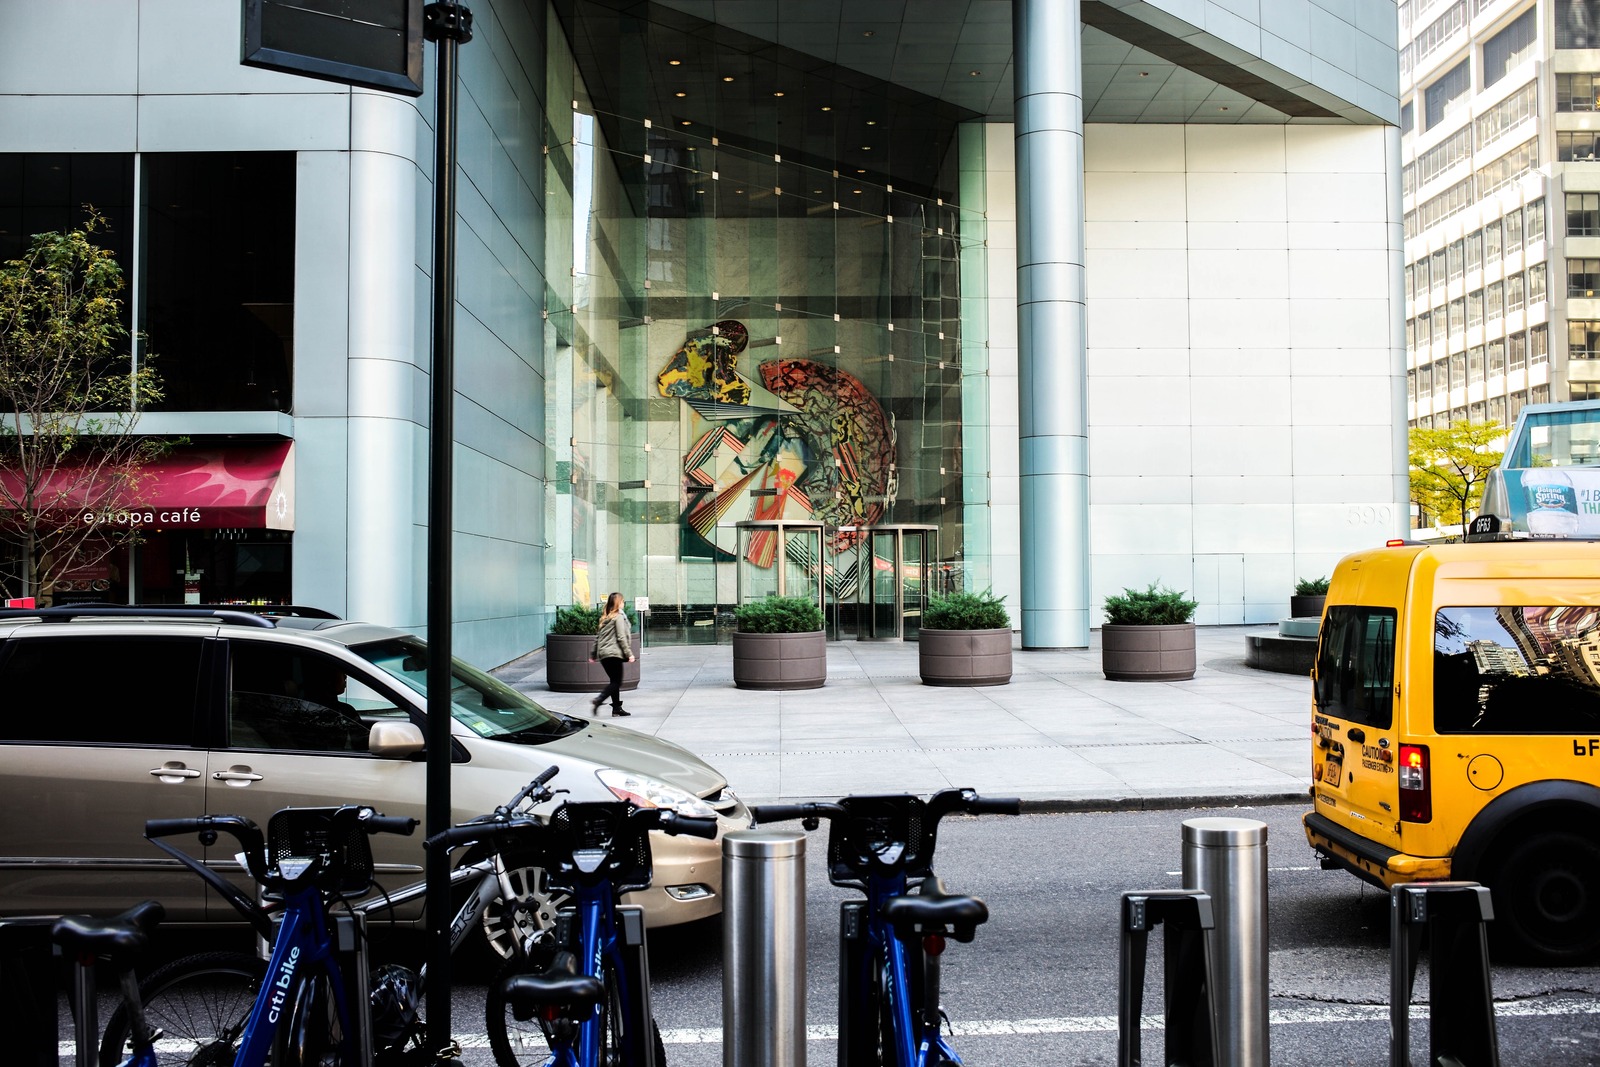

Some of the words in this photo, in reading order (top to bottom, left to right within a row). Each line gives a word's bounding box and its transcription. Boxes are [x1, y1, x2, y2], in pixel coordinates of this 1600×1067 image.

[1536, 491, 1565, 503] Spring
[1537, 486, 1561, 494] Poland
[1580, 489, 1590, 501] #1
[160, 507, 201, 523] café
[1347, 506, 1391, 525] 599
[1476, 517, 1491, 533] 6F63
[276, 946, 300, 989] bike
[268, 990, 286, 1024] citi
